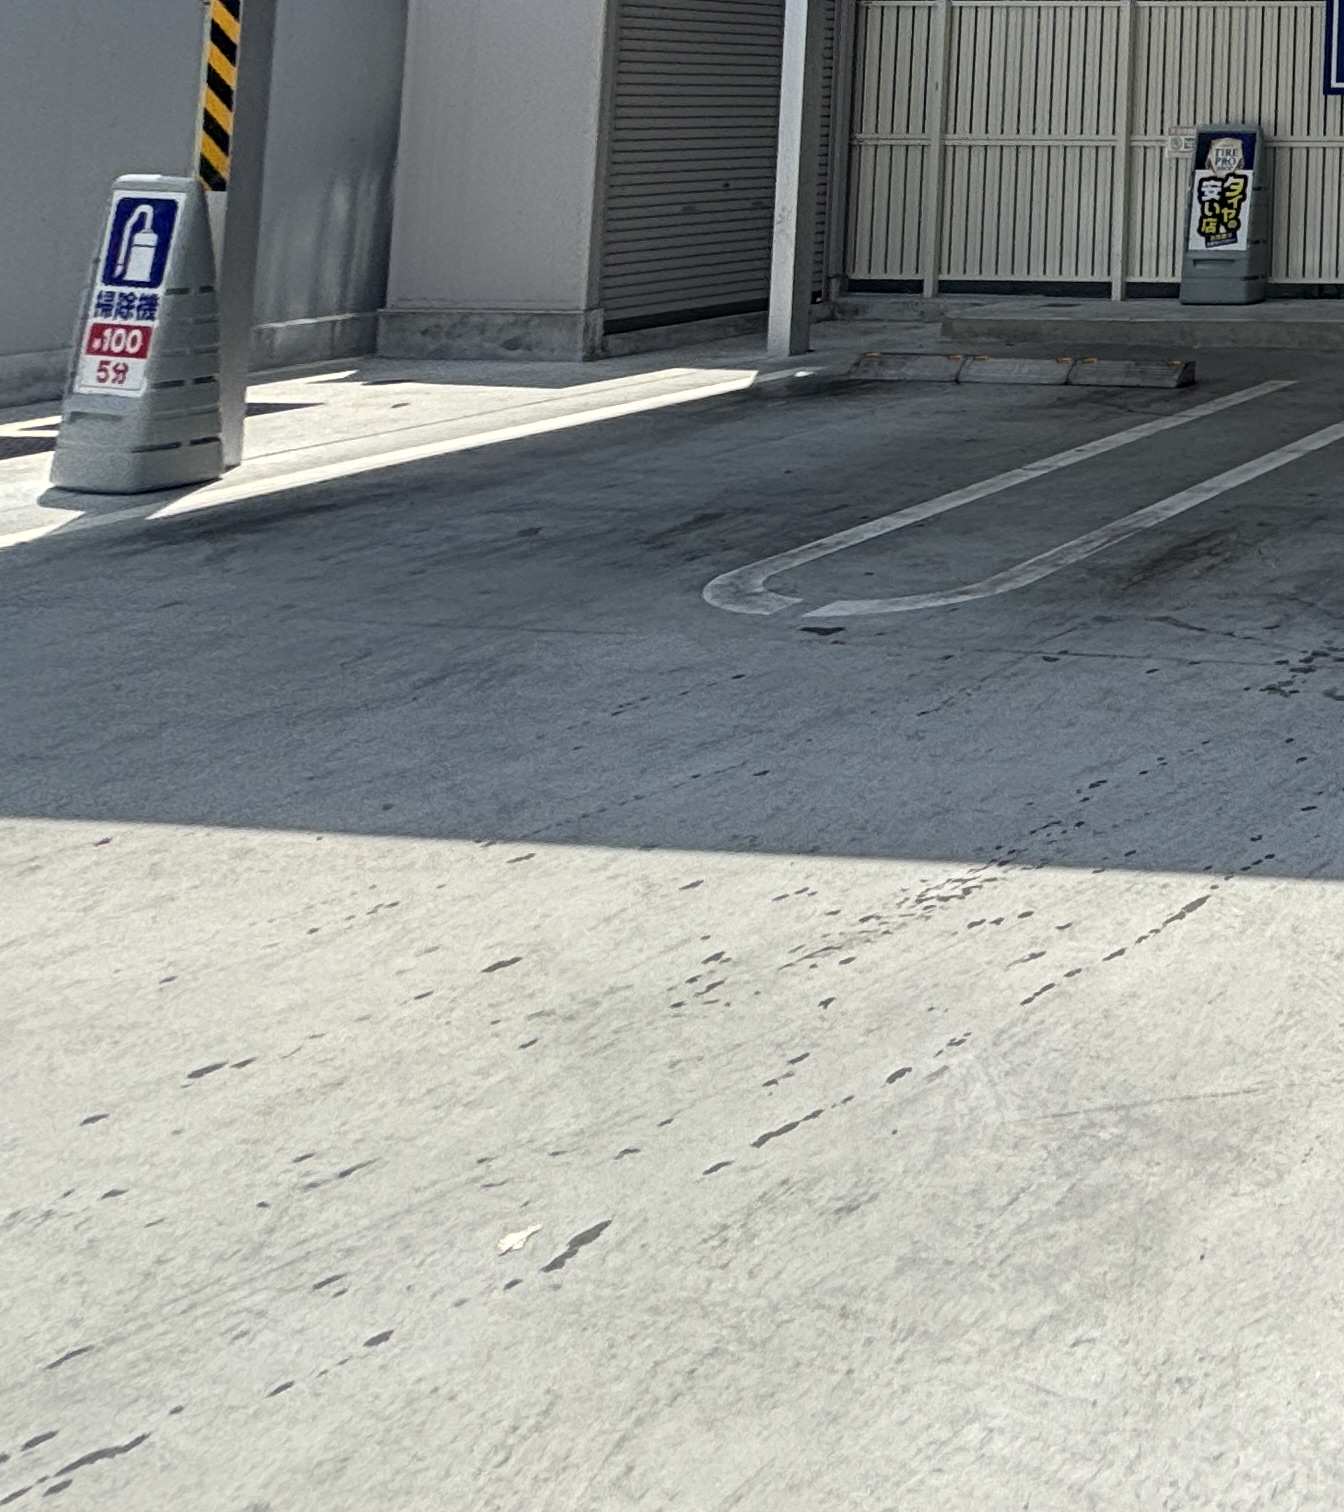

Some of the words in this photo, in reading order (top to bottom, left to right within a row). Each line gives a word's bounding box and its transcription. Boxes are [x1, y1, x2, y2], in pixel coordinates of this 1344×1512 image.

[1215, 157, 1237, 166] PRO
[1200, 180, 1223, 234] 安い店
[96, 360, 130, 385] 5分
